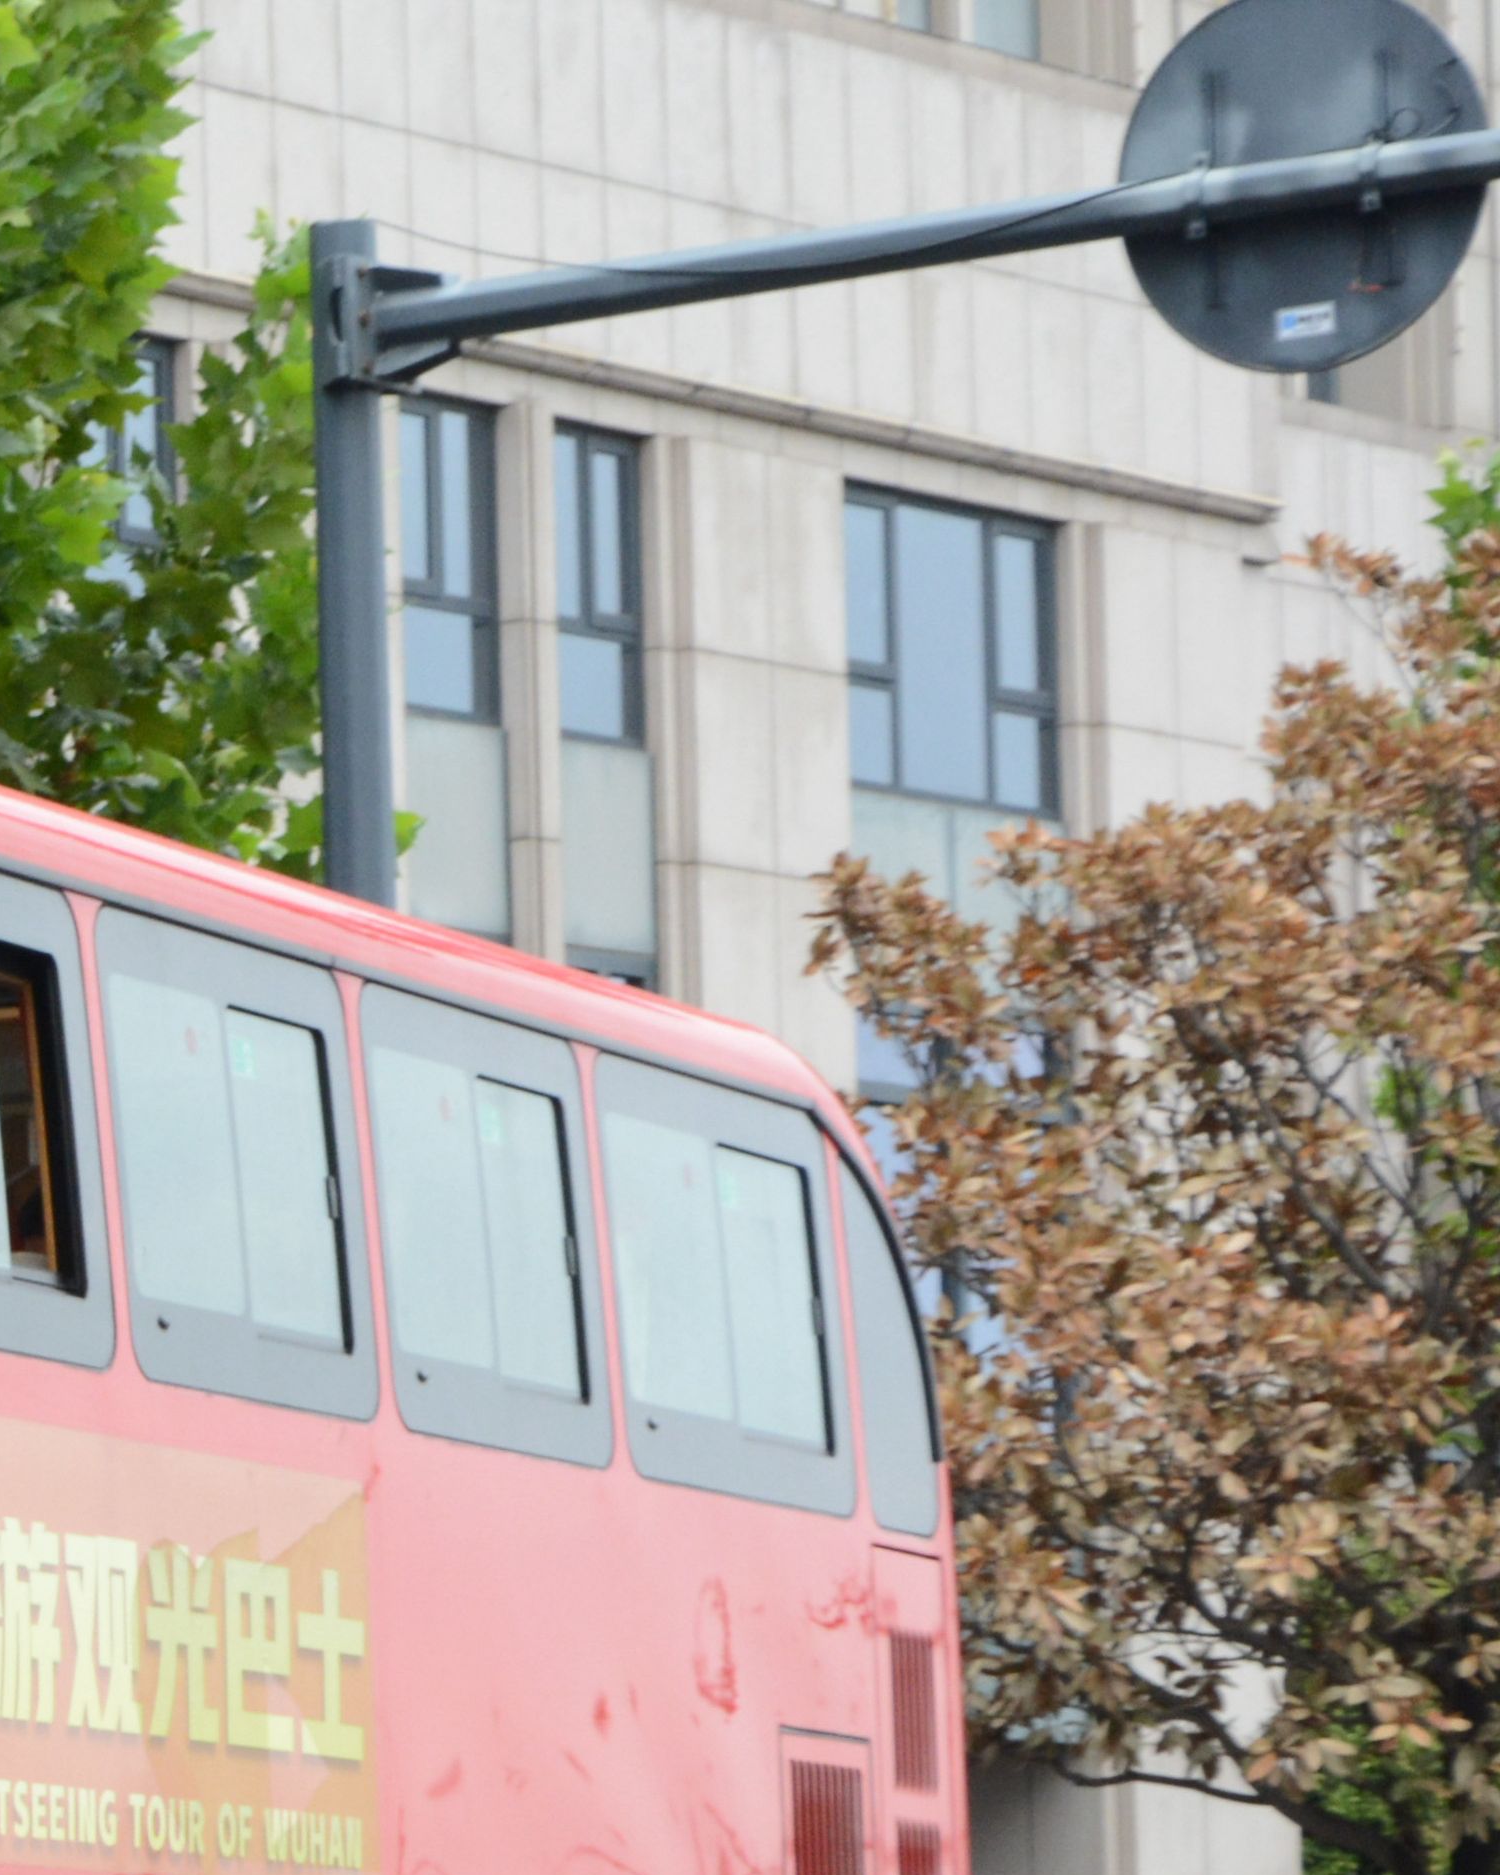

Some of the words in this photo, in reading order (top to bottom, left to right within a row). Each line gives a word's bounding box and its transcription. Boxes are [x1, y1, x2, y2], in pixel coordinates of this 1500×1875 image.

[128, 1793, 205, 1855] TOUR
[217, 1801, 253, 1859] OF
[263, 1807, 363, 1870] WUHAN
